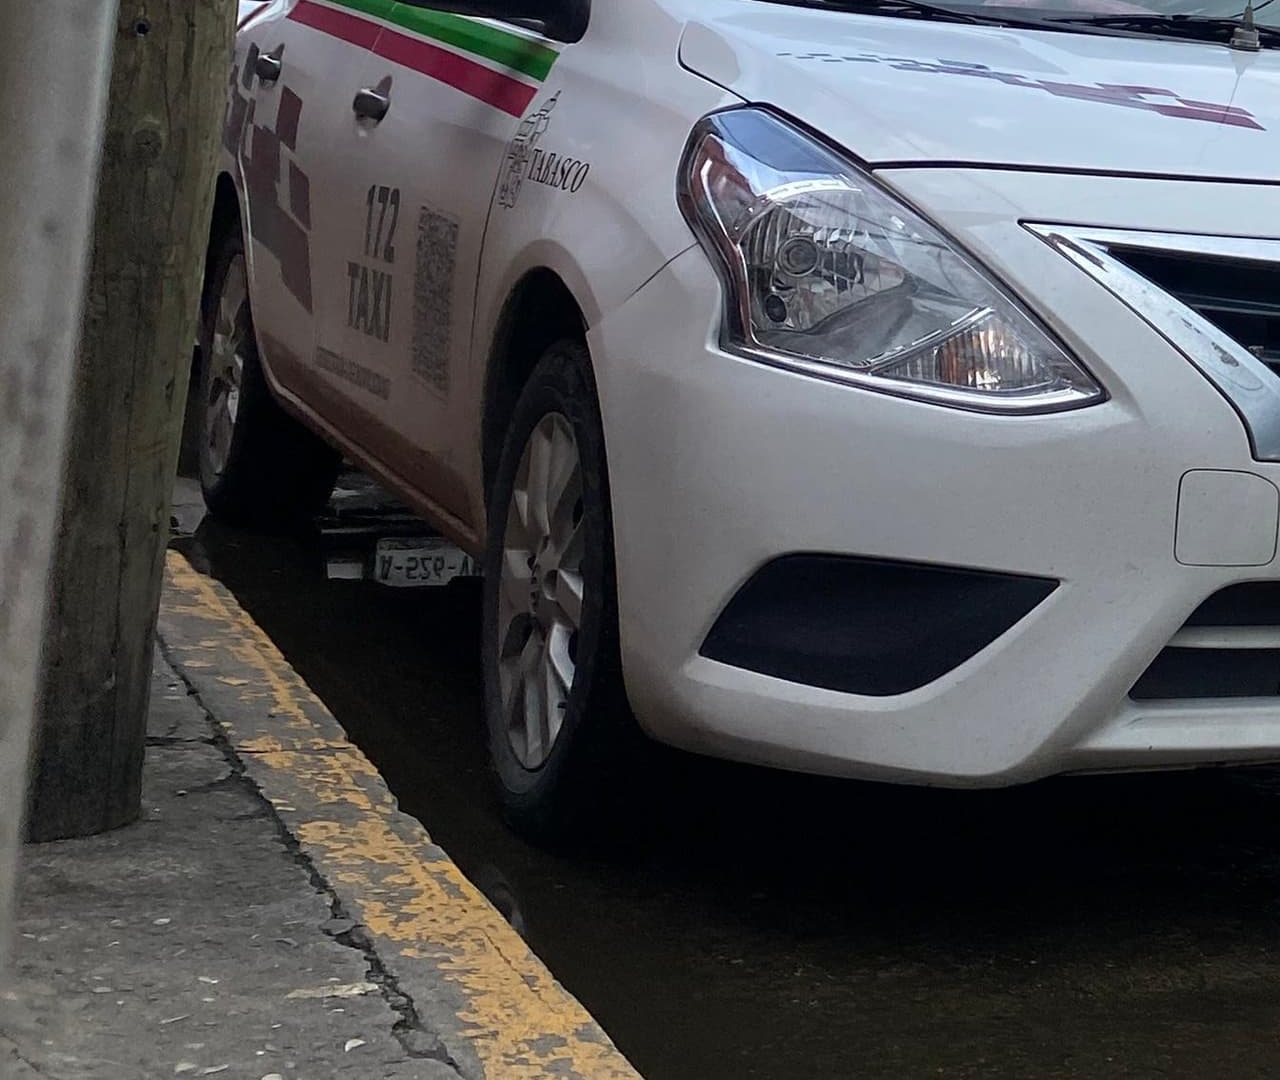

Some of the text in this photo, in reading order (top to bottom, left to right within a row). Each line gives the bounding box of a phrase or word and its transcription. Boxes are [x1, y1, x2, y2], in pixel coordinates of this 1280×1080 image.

[528, 147, 591, 194] TABASCO
[363, 184, 401, 264] 172
[347, 260, 394, 344] TAXI
